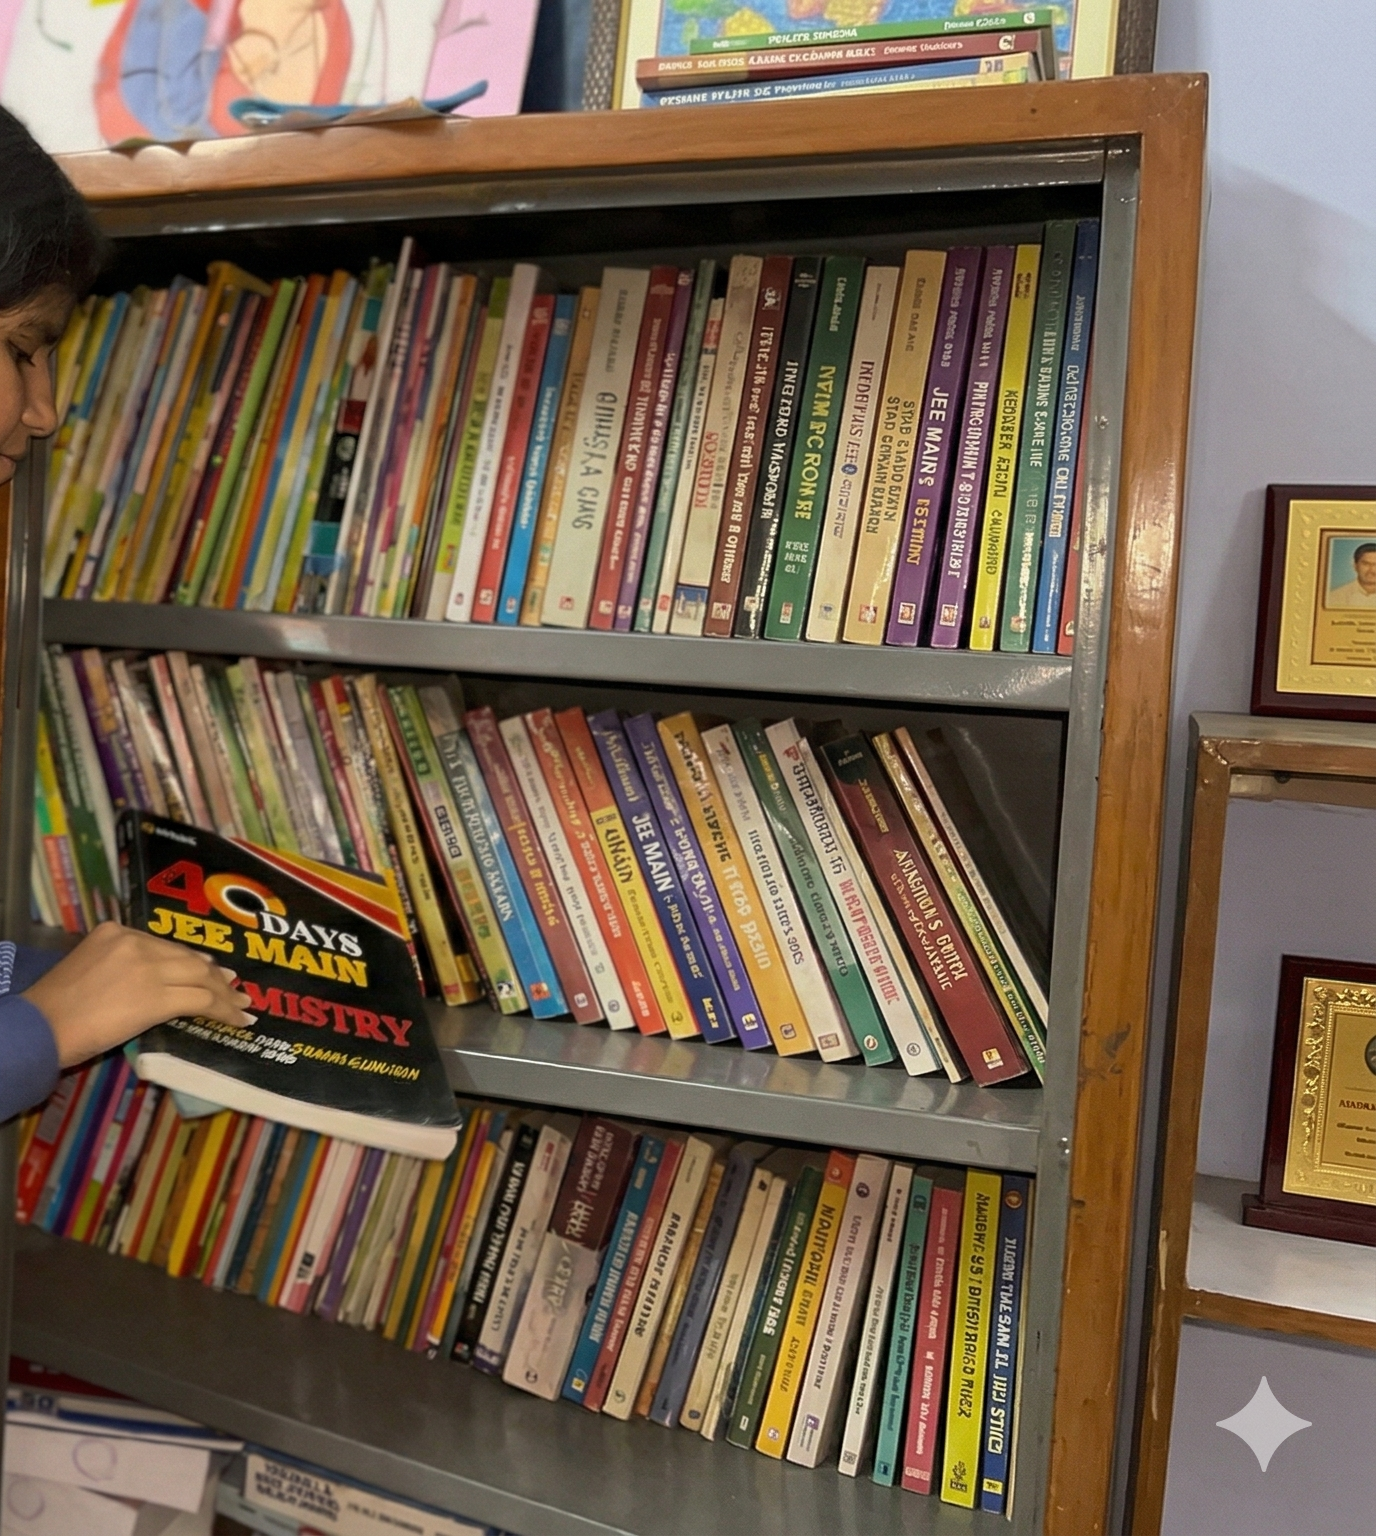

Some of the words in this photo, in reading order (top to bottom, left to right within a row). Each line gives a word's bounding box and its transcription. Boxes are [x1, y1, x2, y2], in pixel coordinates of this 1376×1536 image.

[928, 386, 950, 423] JEE
[631, 812, 656, 842] JEE
[642, 841, 675, 893] MAIN
[146, 859, 288, 930] 40
[147, 907, 234, 953] JEE
[243, 931, 369, 988] MAIN
[260, 911, 363, 957] DAYS
[230, 977, 413, 1047] MISTRY
